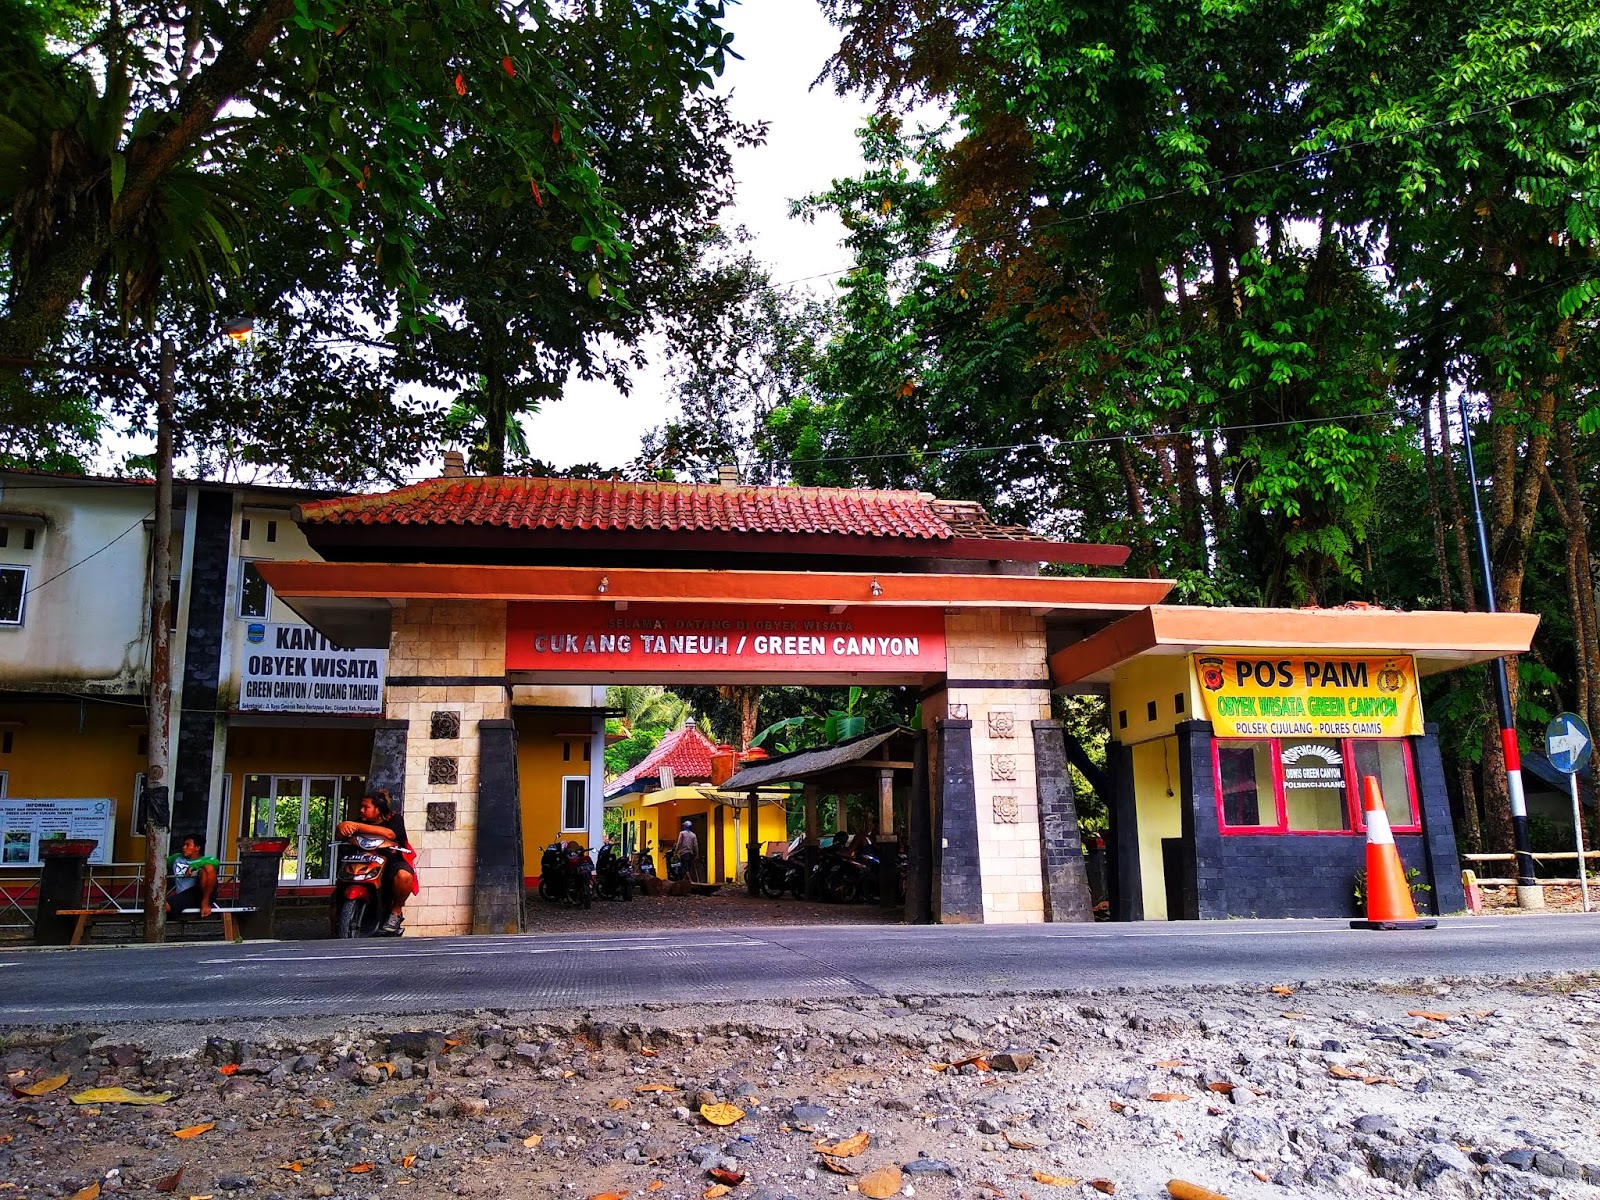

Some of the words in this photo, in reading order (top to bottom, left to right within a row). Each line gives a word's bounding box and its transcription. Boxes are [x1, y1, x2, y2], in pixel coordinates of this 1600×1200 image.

[608, 619, 668, 629] SELAMAT
[676, 620, 730, 630] DATANG
[736, 621, 750, 631] DI
[755, 621, 798, 631] OBYEK
[803, 621, 853, 632] WISATA
[534, 634, 632, 653] CUKANG
[640, 635, 728, 655] TANEUH
[735, 636, 747, 655] /
[754, 636, 826, 655] GREEN
[832, 637, 920, 656] CANYON
[248, 655, 308, 677] OBYEK
[311, 658, 379, 679] WISATA
[1235, 660, 1294, 688] POS
[1303, 660, 1369, 688] PAM
[246, 681, 273, 698] GREEN
[274, 681, 306, 699] CANYON
[307, 682, 312, 699] /
[314, 682, 347, 700] CUKANG
[348, 684, 379, 701] TANEUH
[1217, 696, 1257, 716] OBYEK
[1258, 696, 1306, 716] WISATA
[1307, 696, 1346, 717] GREEN
[1349, 696, 1398, 717] CANYON
[1236, 722, 1268, 734] POLSEK
[1270, 722, 1313, 734] CIJULANG
[1319, 722, 1350, 734] POLRES
[1352, 722, 1382, 734] CIAMIS
[1302, 768, 1320, 779] GREEN
[1320, 768, 1341, 779] CANYON
